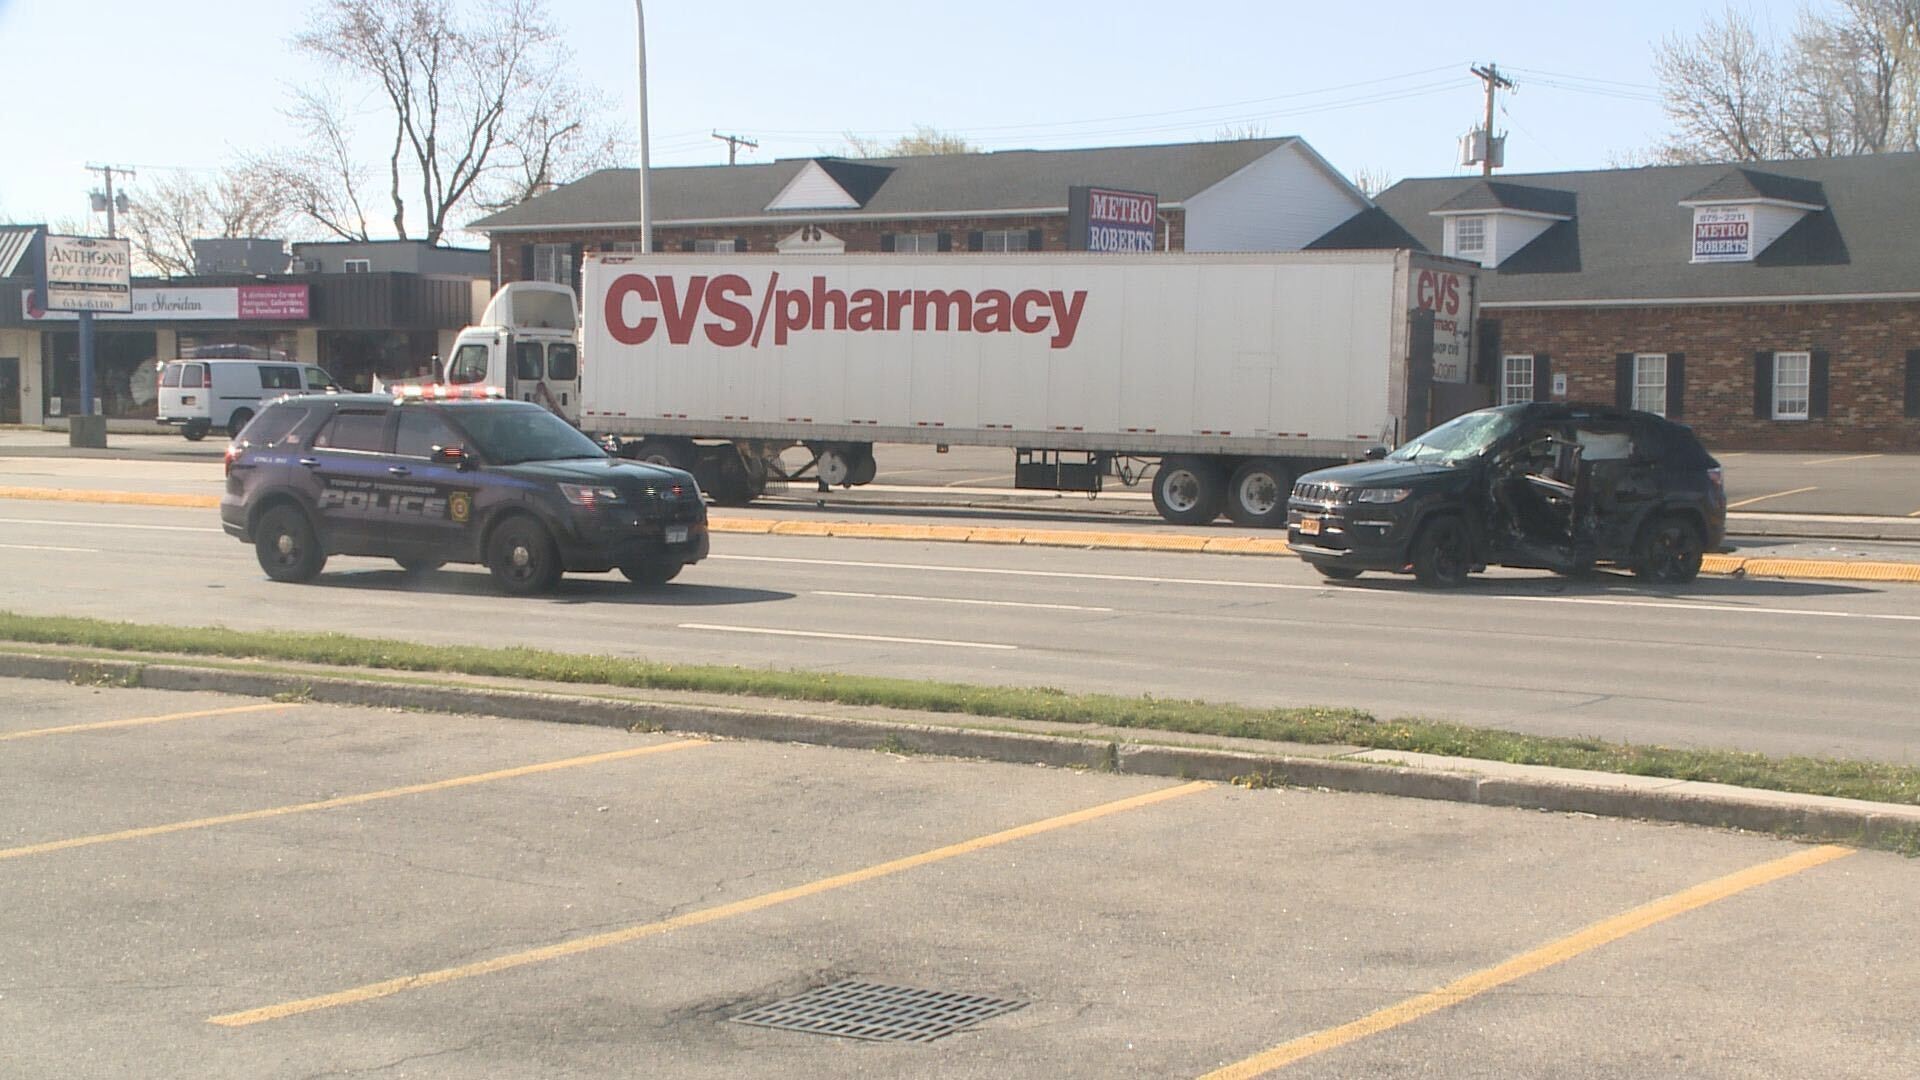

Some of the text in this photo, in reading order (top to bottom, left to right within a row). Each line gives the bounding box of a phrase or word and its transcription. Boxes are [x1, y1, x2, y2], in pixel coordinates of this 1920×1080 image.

[1091, 194, 1152, 225] METRO
[1090, 226, 1153, 252] ROBERTS
[1697, 223, 1746, 238] METRO
[49, 245, 126, 265] ANTHONE
[1696, 239, 1747, 254] ROBERTS
[52, 264, 123, 278] eye center
[152, 293, 202, 312] Sheridan
[1417, 270, 1459, 315] CVS
[604, 271, 1088, 349] CVS/pharmacy
[317, 489, 447, 515] POLICE
